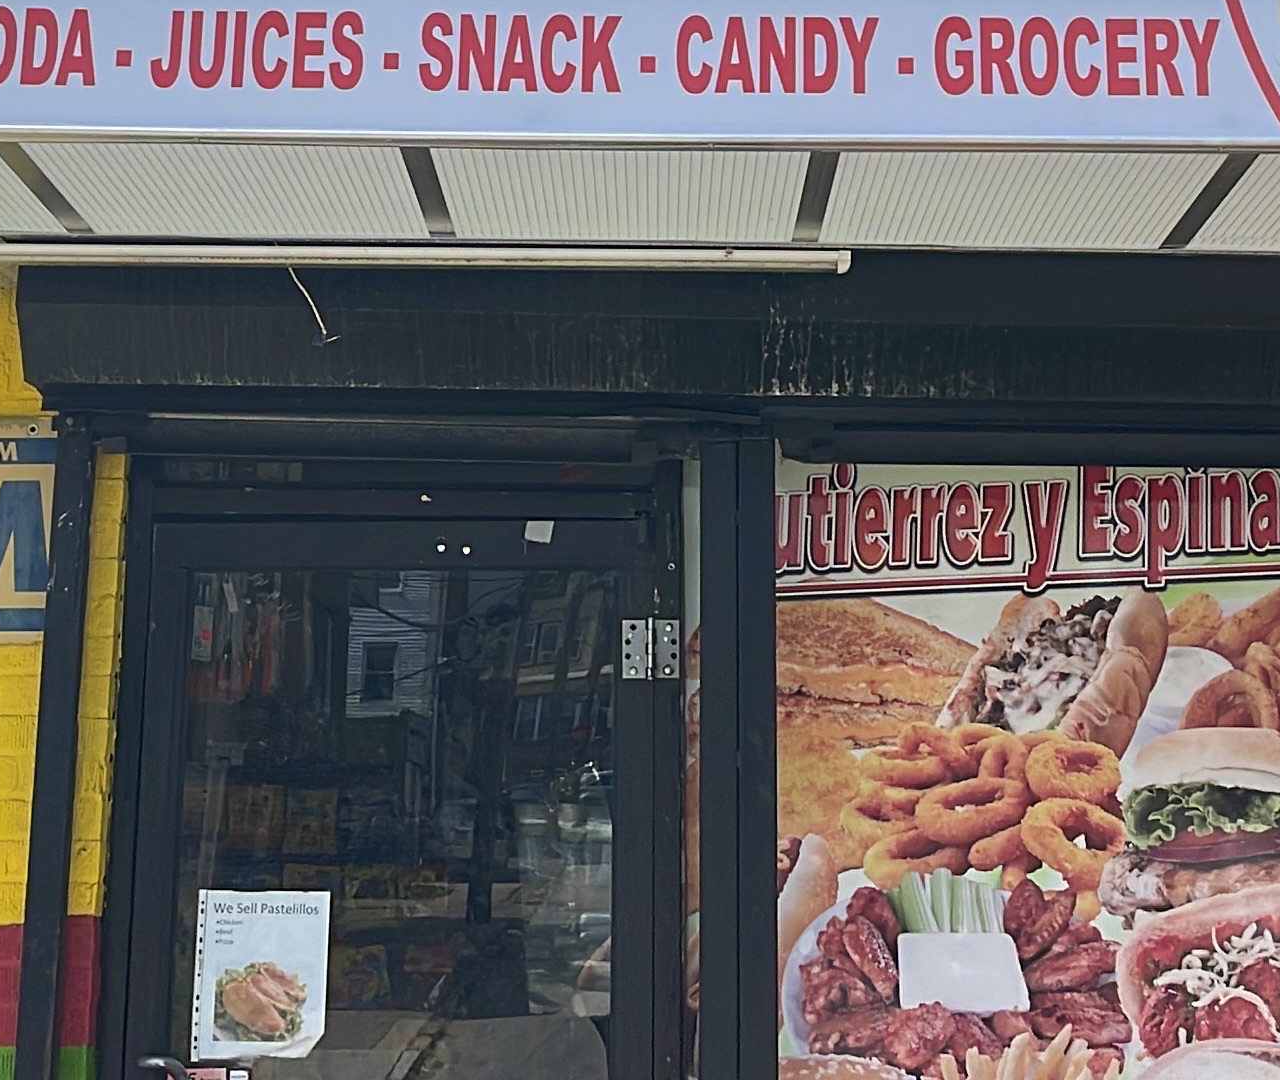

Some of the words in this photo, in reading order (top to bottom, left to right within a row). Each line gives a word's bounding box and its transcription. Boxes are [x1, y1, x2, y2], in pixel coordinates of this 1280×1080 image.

[150, 10, 364, 91] JUICES
[419, 12, 622, 94] SNACK
[675, 15, 879, 96] CANDY
[933, 16, 1222, 98] GROCERY
[775, 463, 1013, 572] utierrez
[1023, 479, 1068, 592] y
[213, 903, 234, 914] We
[237, 902, 257, 914] Sell
[260, 902, 320, 915] Pastelillos
